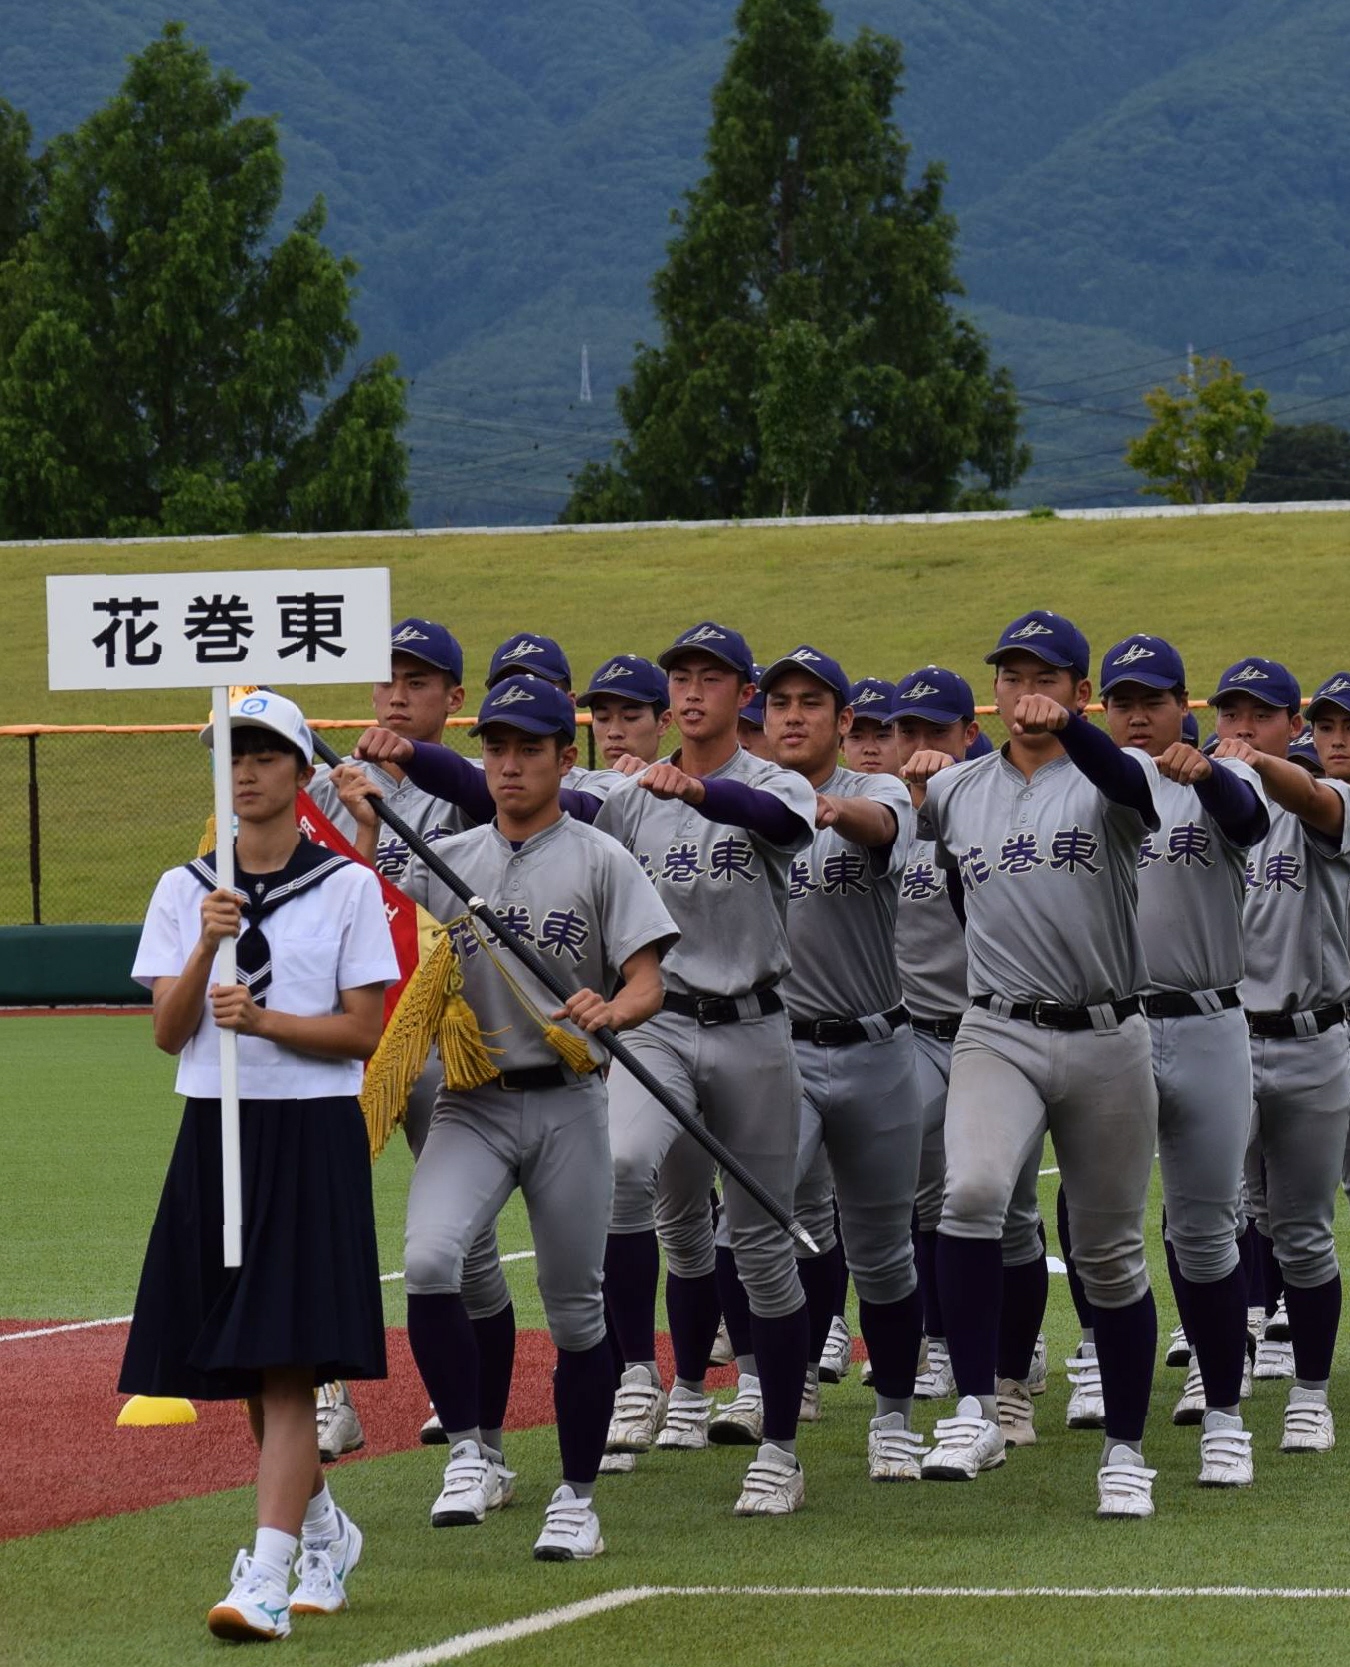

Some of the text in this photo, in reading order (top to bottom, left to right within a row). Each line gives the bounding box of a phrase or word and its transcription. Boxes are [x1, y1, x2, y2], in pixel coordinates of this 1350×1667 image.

[92, 592, 347, 668] 花巻東
[959, 824, 1103, 892] 花巻東
